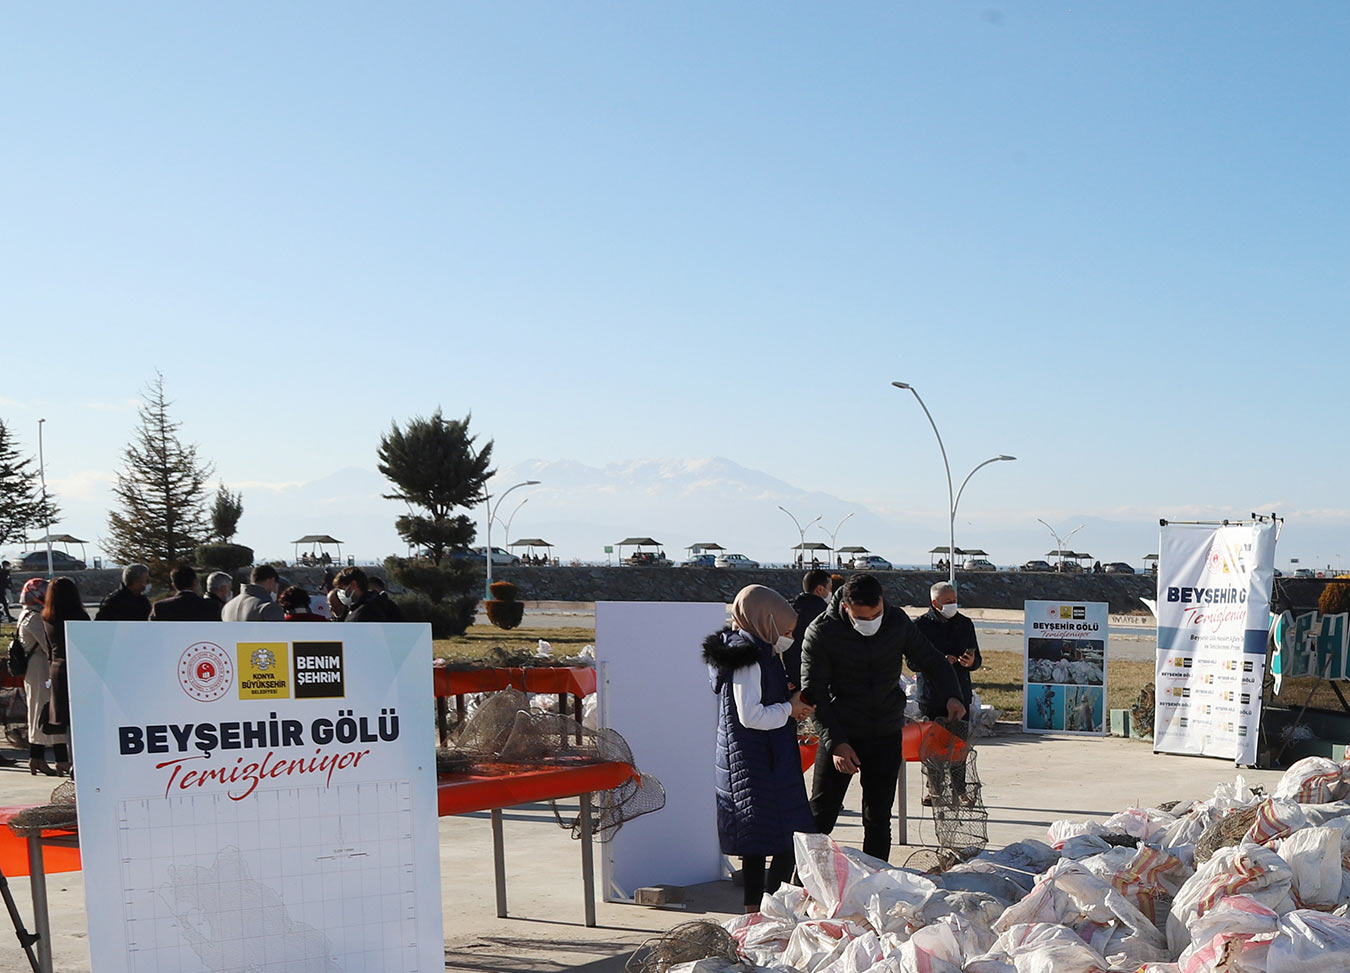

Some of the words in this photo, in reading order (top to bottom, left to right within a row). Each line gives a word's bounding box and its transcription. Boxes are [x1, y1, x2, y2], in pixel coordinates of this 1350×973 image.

[1033, 621, 1075, 631] BEYŞEHİR
[1076, 623, 1099, 631] GÖLÜ
[297, 656, 340, 670] BENİM
[241, 679, 286, 689] BÜYÜKŞEHİR
[297, 672, 341, 685] ŞEHRİM
[118, 712, 303, 758] BEYŞEHİR
[311, 708, 400, 746] GÖLÜ
[155, 748, 370, 801] Temizleniyor
